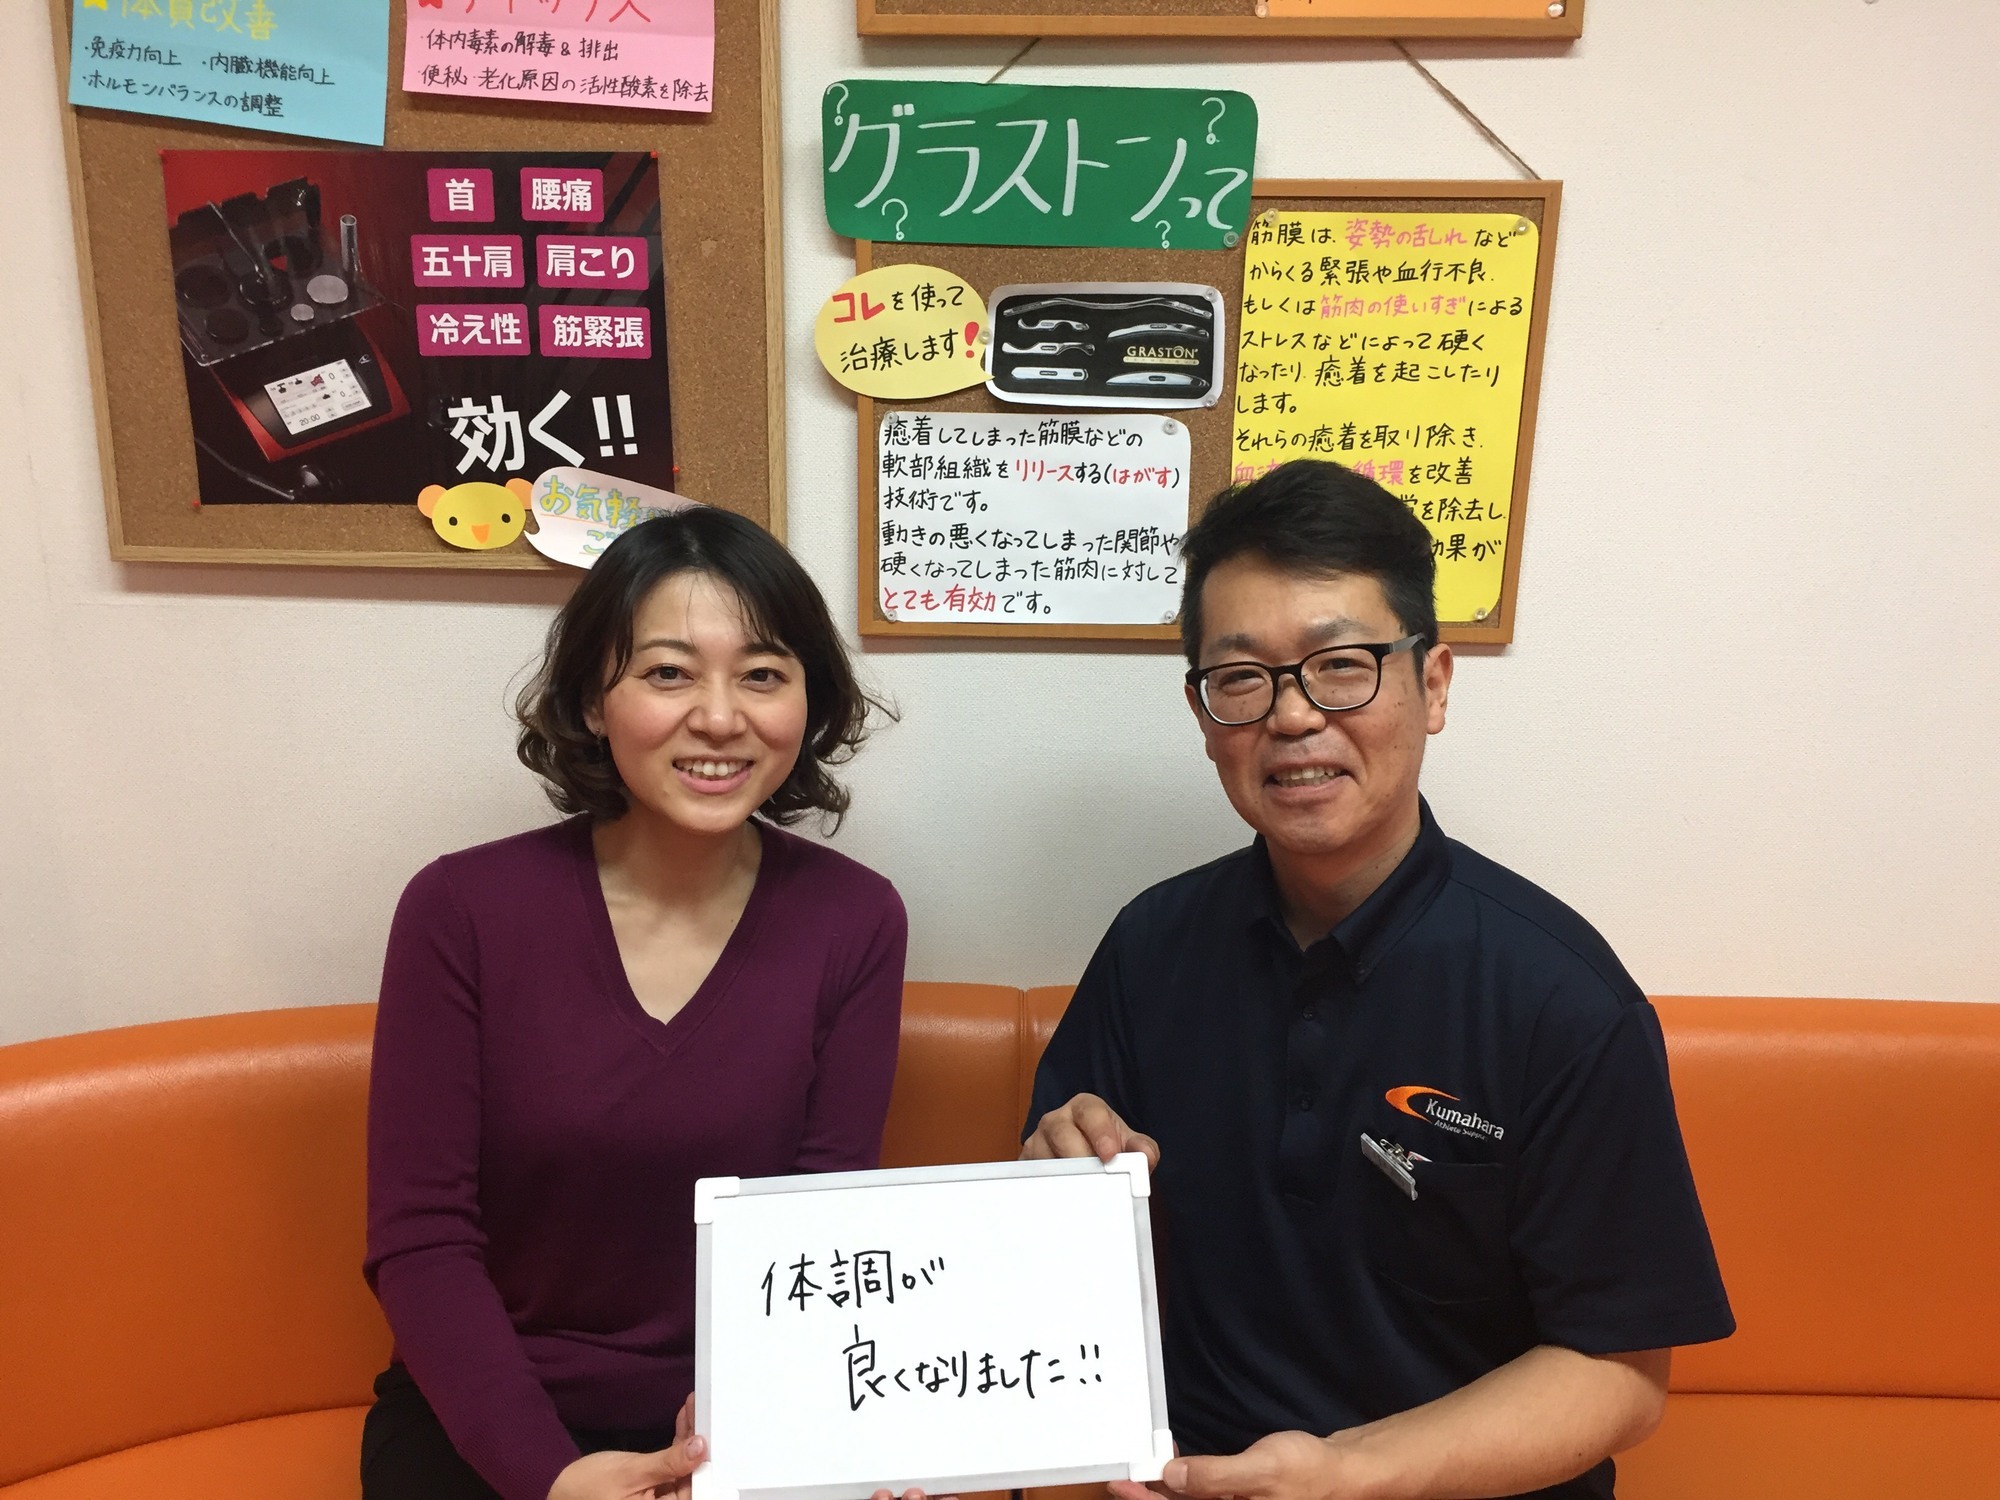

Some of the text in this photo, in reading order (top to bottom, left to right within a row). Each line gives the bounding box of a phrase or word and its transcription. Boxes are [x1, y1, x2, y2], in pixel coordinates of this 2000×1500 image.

[828, 103, 1248, 230] グラストンって
[445, 178, 475, 212] 首
[531, 178, 593, 212] 腰痛
[421, 245, 512, 278] 五十肩
[546, 244, 635, 279] 肩こり
[832, 282, 964, 324] コレを使って
[429, 313, 522, 345] 冷え性
[552, 314, 645, 348] 筋緊張
[1236, 392, 1297, 414] します。
[447, 389, 639, 475] 効く!!
[540, 474, 655, 529] お気軽
[883, 486, 989, 514] 技術です。
[883, 583, 1052, 615] とても有効です。
[1426, 1098, 1504, 1140] Kumahara
[761, 1249, 945, 1316] 体調が
[843, 1324, 1103, 1411] 良くなりました!!
